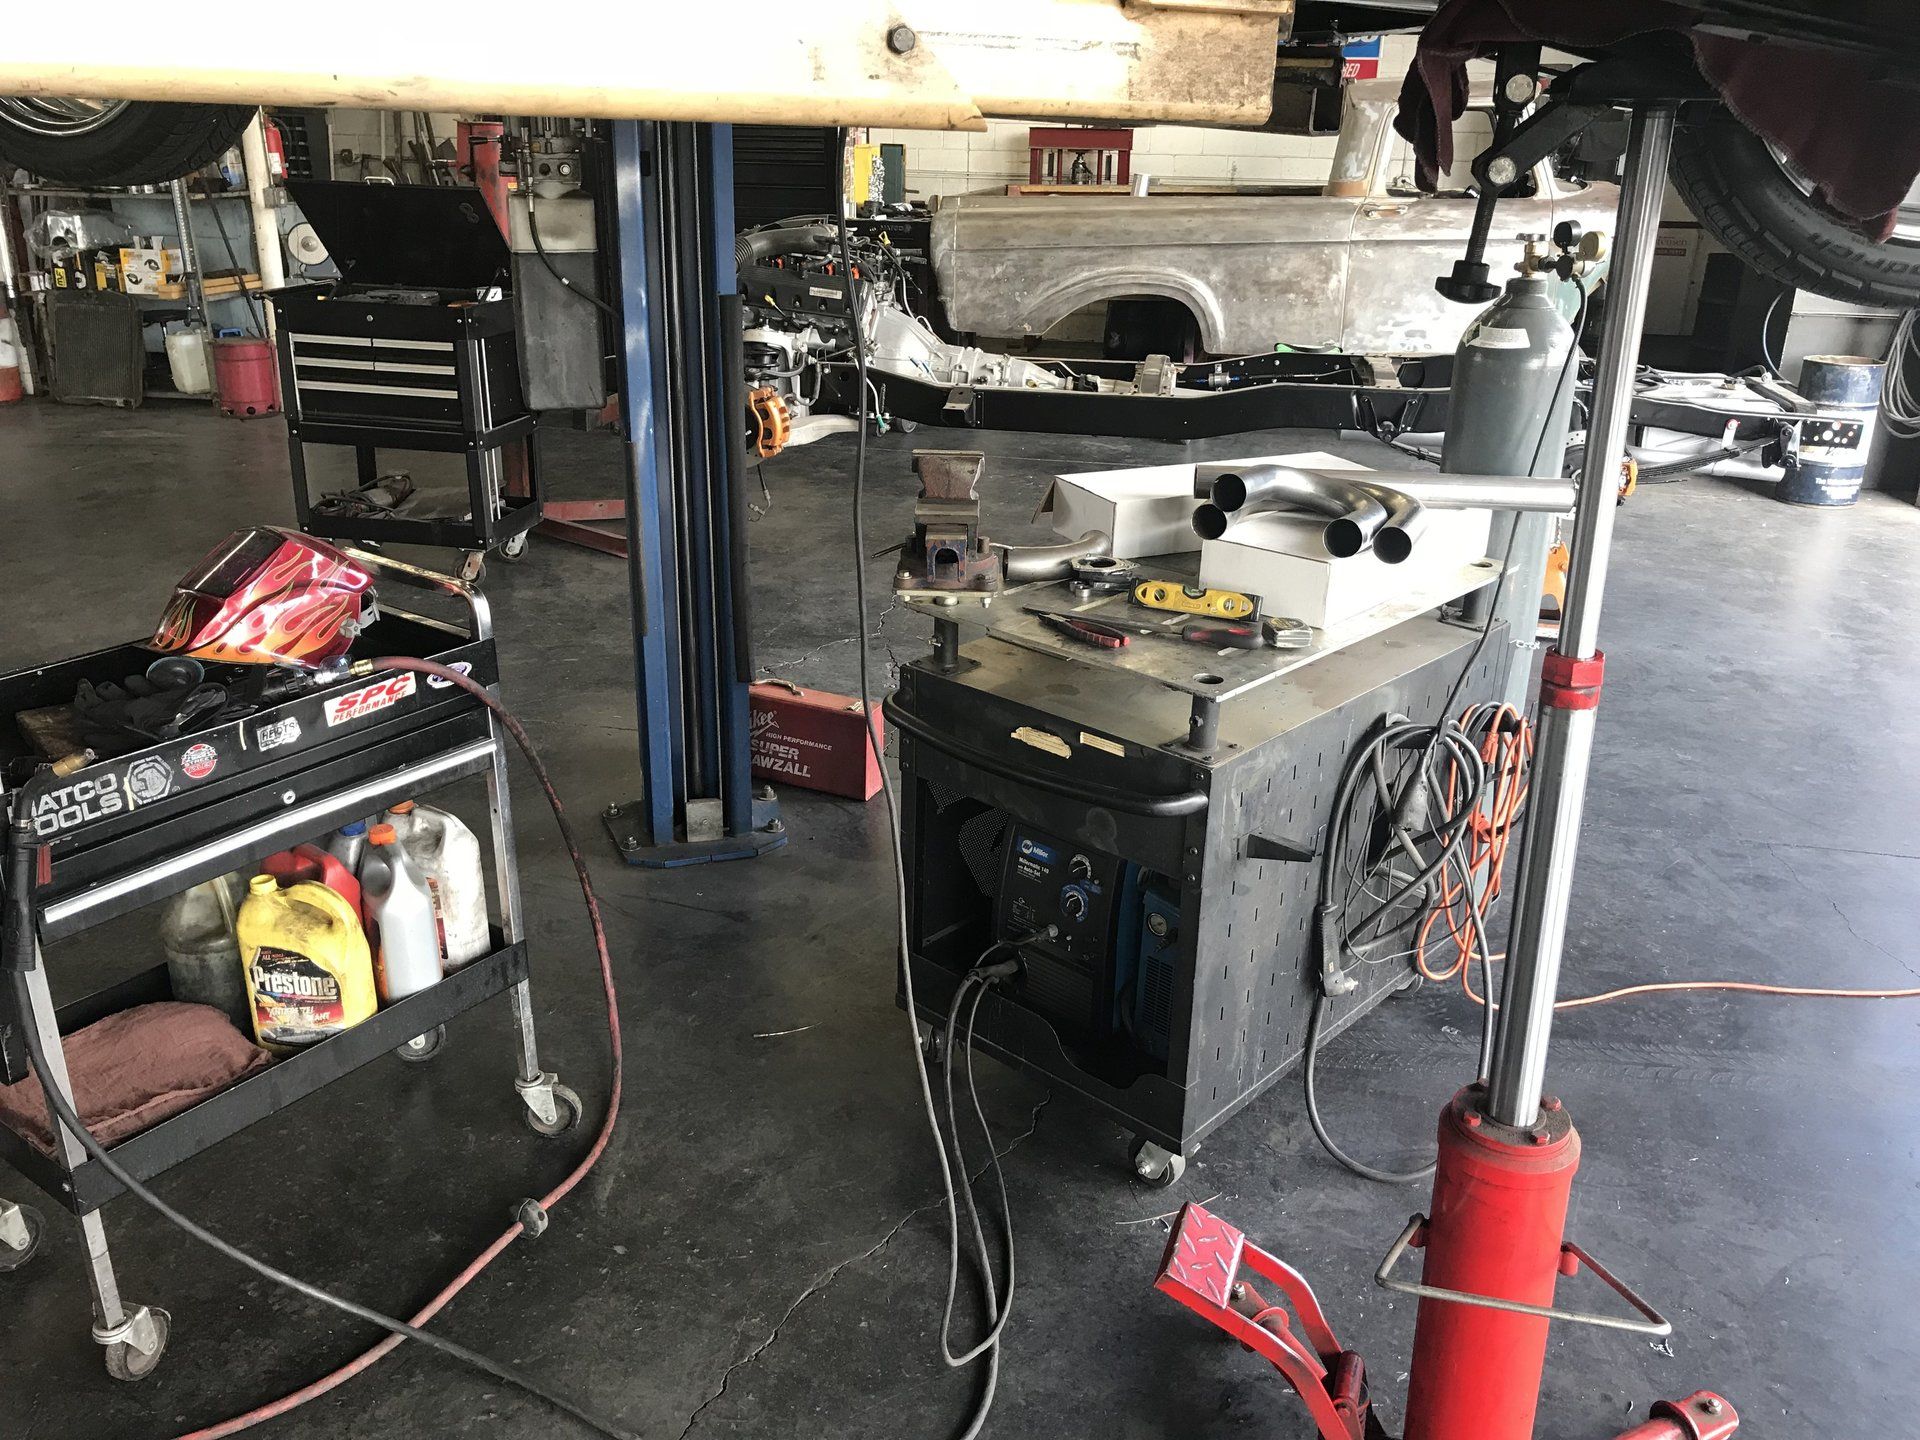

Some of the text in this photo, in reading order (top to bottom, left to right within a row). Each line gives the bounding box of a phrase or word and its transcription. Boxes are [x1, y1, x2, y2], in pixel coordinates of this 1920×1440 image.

[333, 690, 407, 723] PERFORMANCE
[335, 676, 411, 714] SPC
[751, 739, 800, 760] SUPER
[766, 732, 832, 751] HIGH PERFORMANCE
[752, 754, 811, 778] AWZALL
[34, 792, 123, 836] OOLS
[253, 966, 337, 995] Prestone
